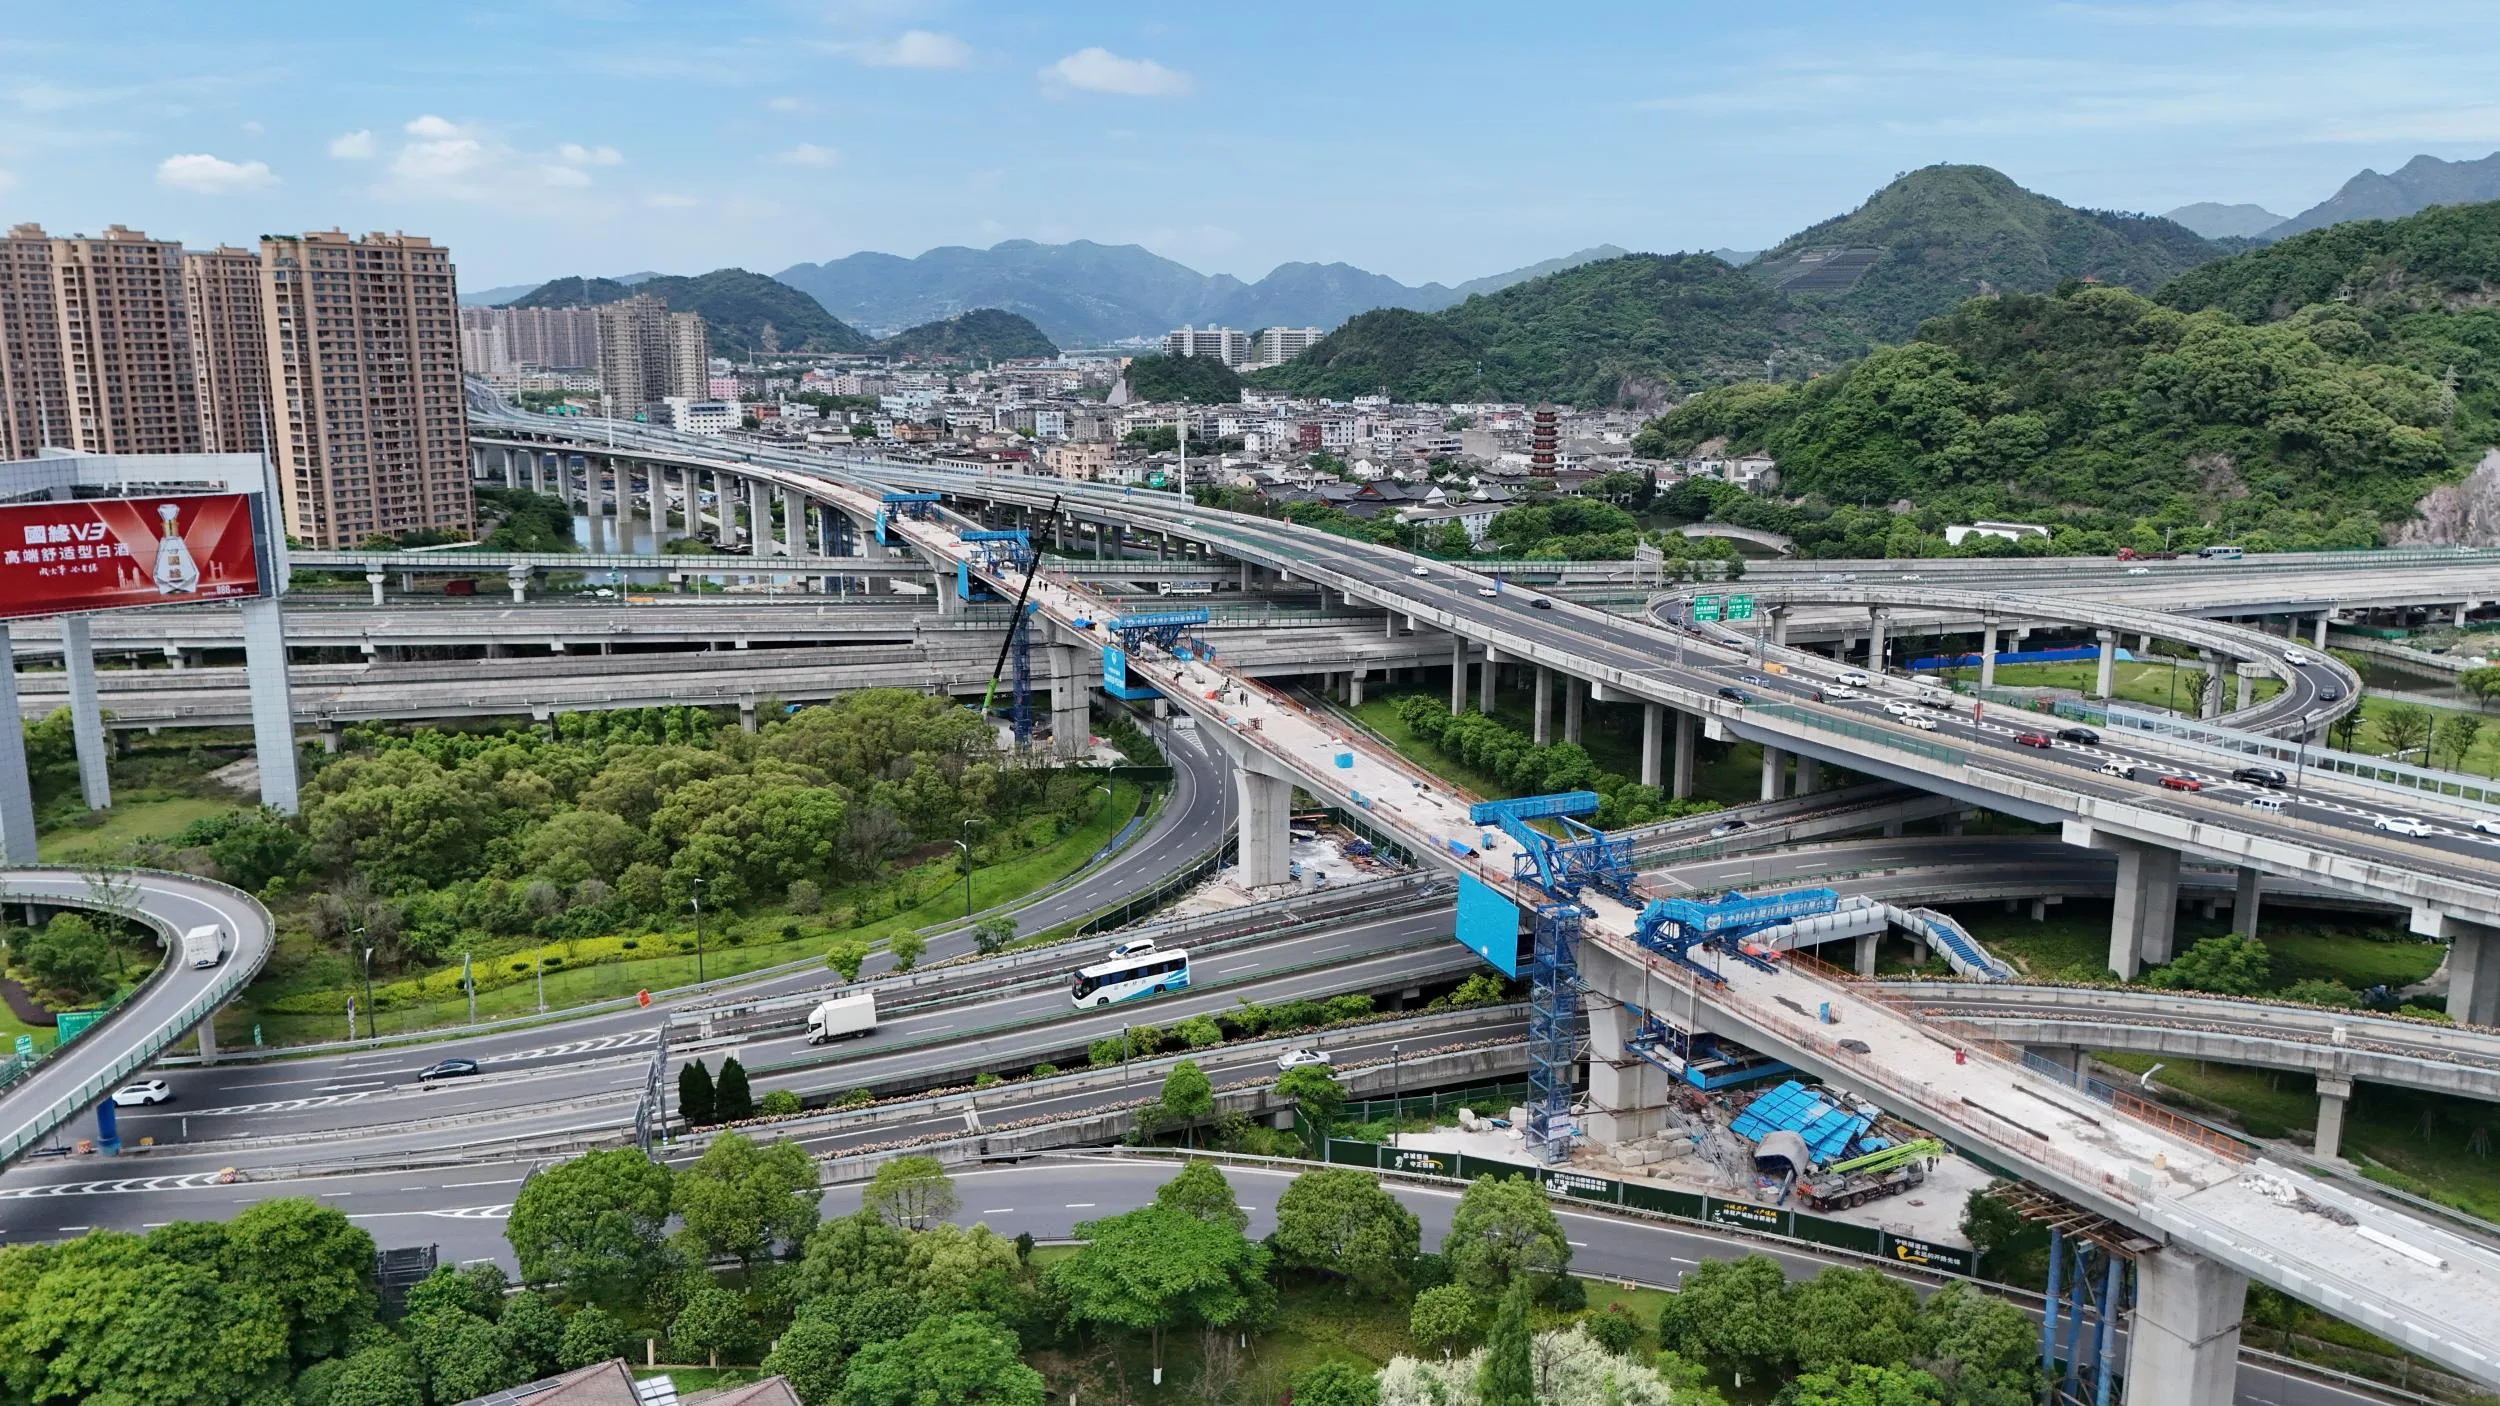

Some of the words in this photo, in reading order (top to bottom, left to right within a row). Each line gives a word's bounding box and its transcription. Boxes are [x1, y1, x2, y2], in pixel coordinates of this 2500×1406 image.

[3, 542, 131, 565] 高端舒适型白酒
[1894, 1238, 1928, 1250] 中铁隧道局
[1914, 1249, 1961, 1266] 永远的开路先锋
